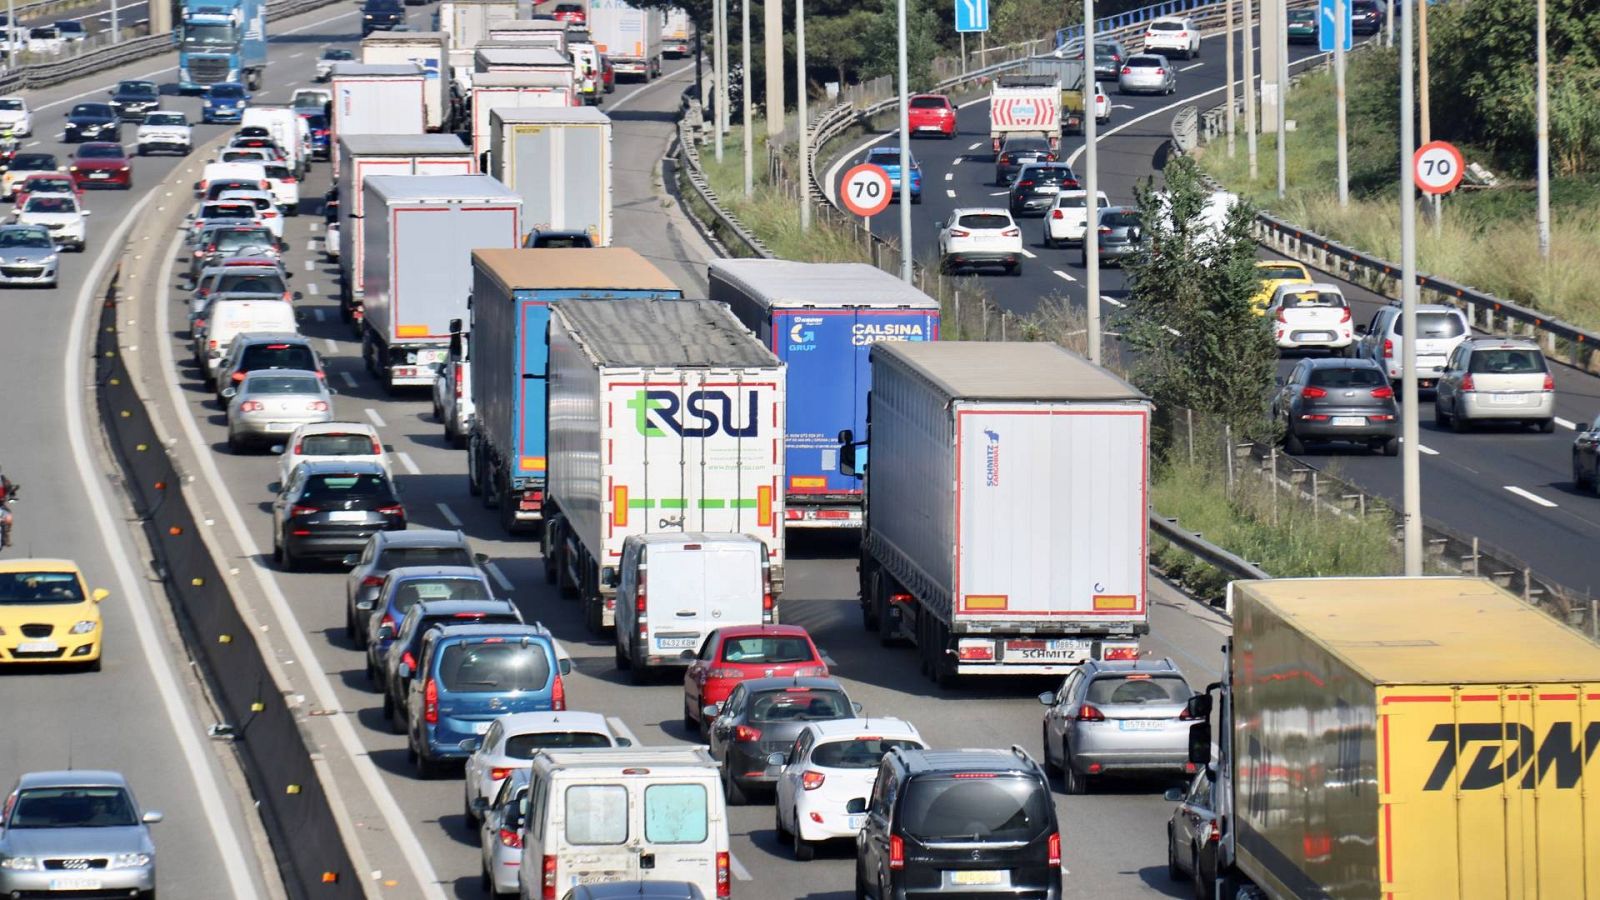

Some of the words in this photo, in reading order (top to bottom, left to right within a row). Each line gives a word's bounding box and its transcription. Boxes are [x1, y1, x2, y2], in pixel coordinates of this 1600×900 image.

[1424, 160, 1450, 176] 70
[853, 181, 880, 198] 70
[852, 324, 922, 335] CALSINA
[789, 344, 817, 352] GRUP
[1022, 650, 1075, 659] SCHMITZ
